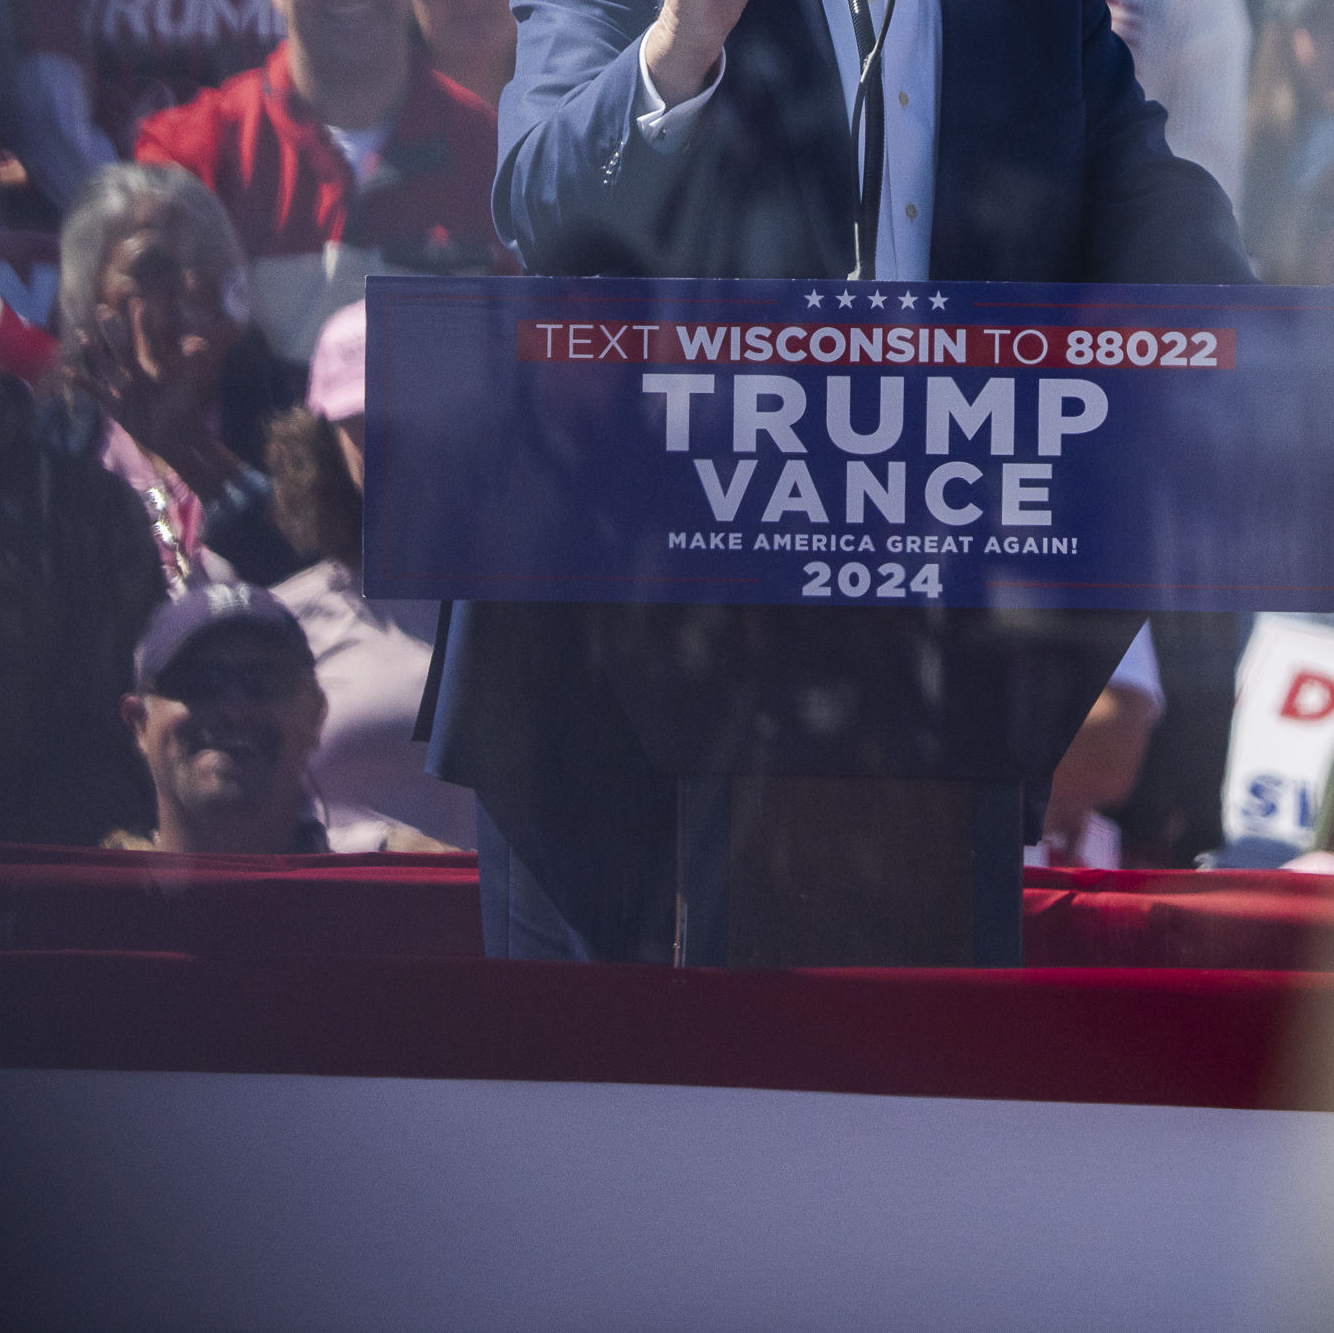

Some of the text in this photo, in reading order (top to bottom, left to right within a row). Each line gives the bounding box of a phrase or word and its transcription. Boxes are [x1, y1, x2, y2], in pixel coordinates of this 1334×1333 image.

[536, 324, 1218, 366] TEXT WISCONSIN TO 88022
[642, 373, 1109, 456] TRUMP
[693, 459, 1053, 526] VANCE
[668, 532, 1078, 555] MAKE AMERICA GREAT AGAIN!
[802, 561, 943, 599] 2024
